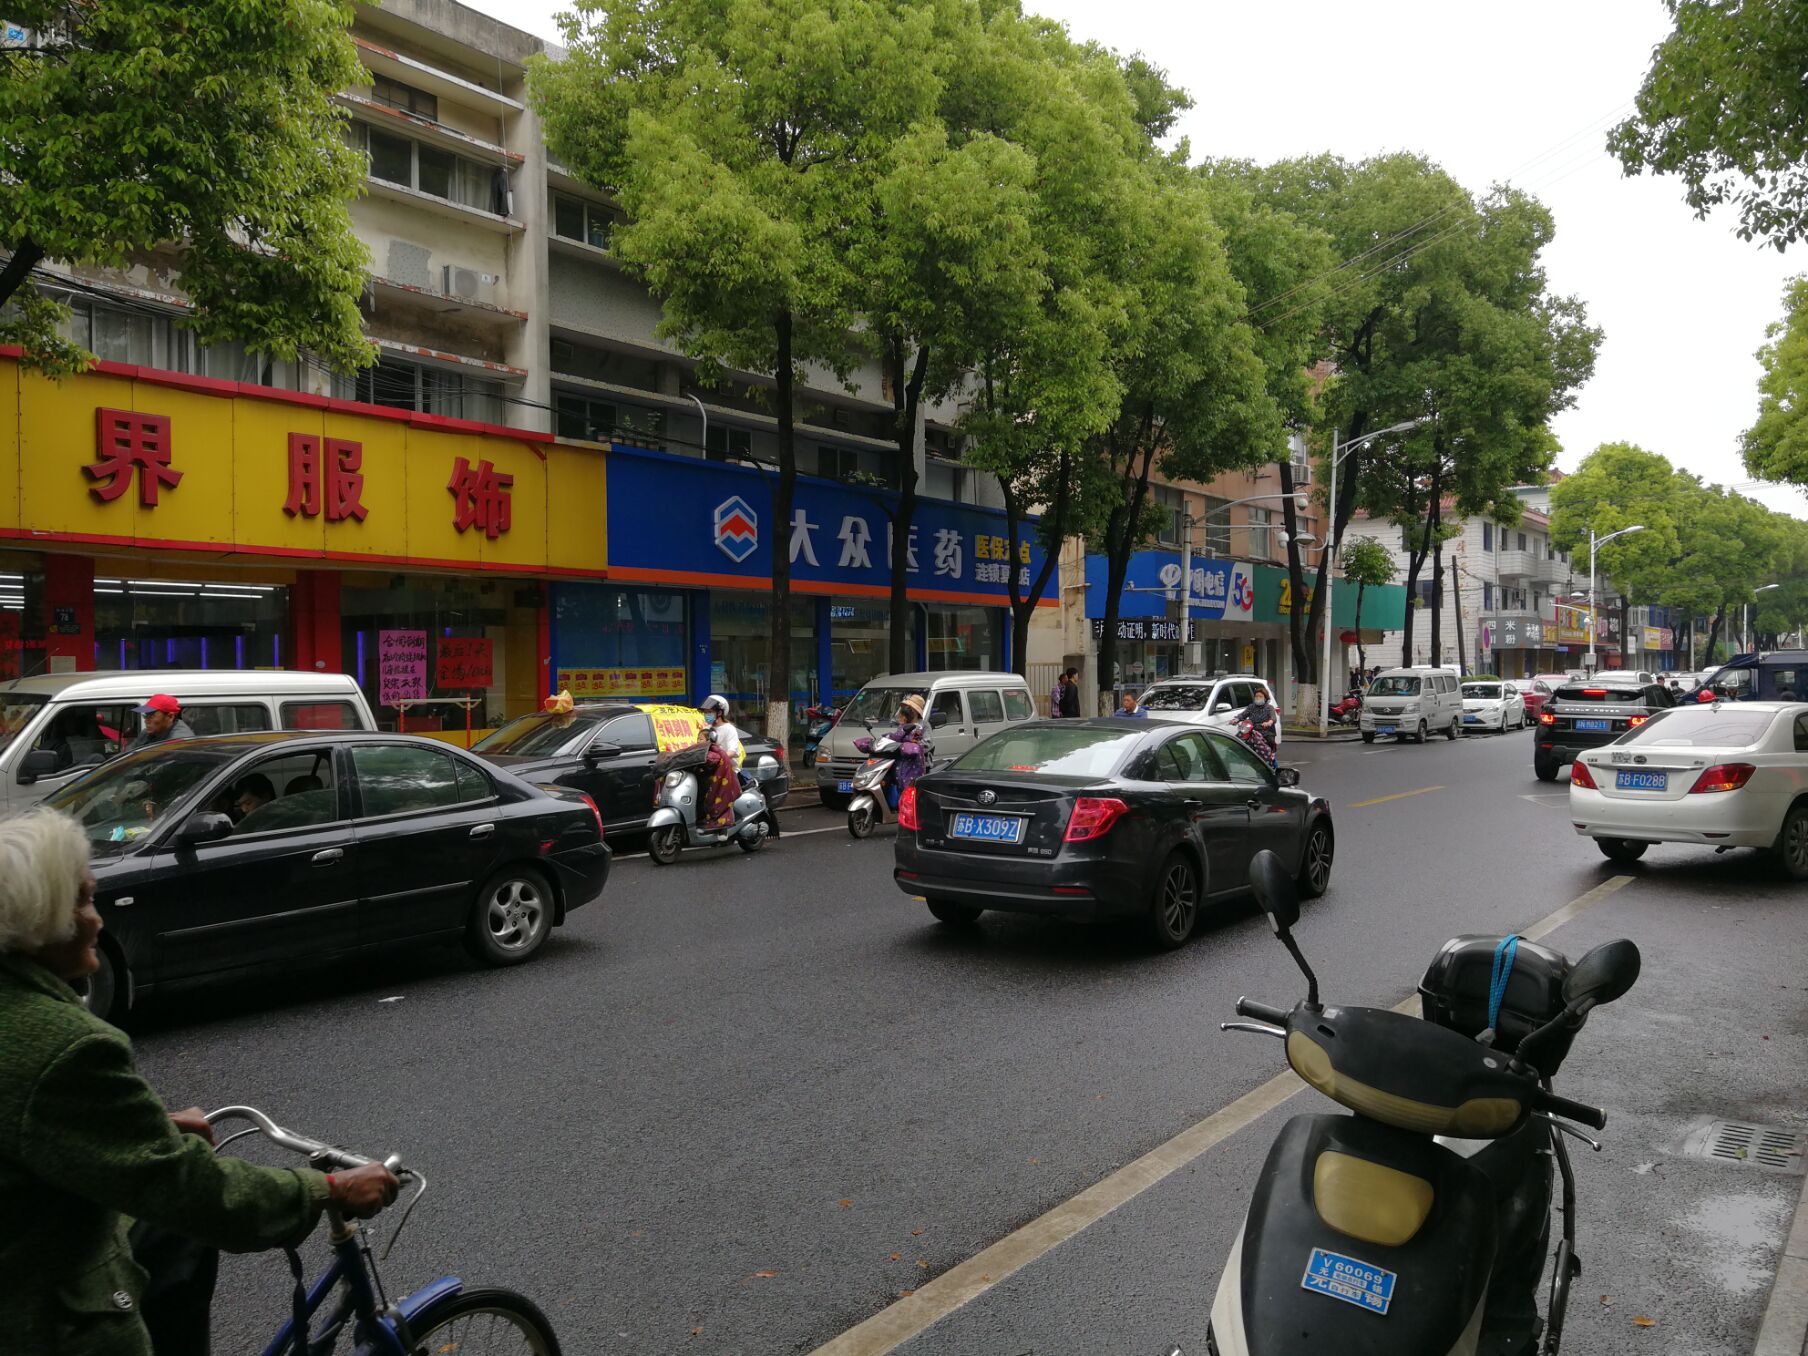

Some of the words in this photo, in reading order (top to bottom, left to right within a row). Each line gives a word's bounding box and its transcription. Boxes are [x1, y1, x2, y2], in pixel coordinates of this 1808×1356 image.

[81, 406, 514, 540] 界服饰
[1232, 571, 1254, 612] 5G
